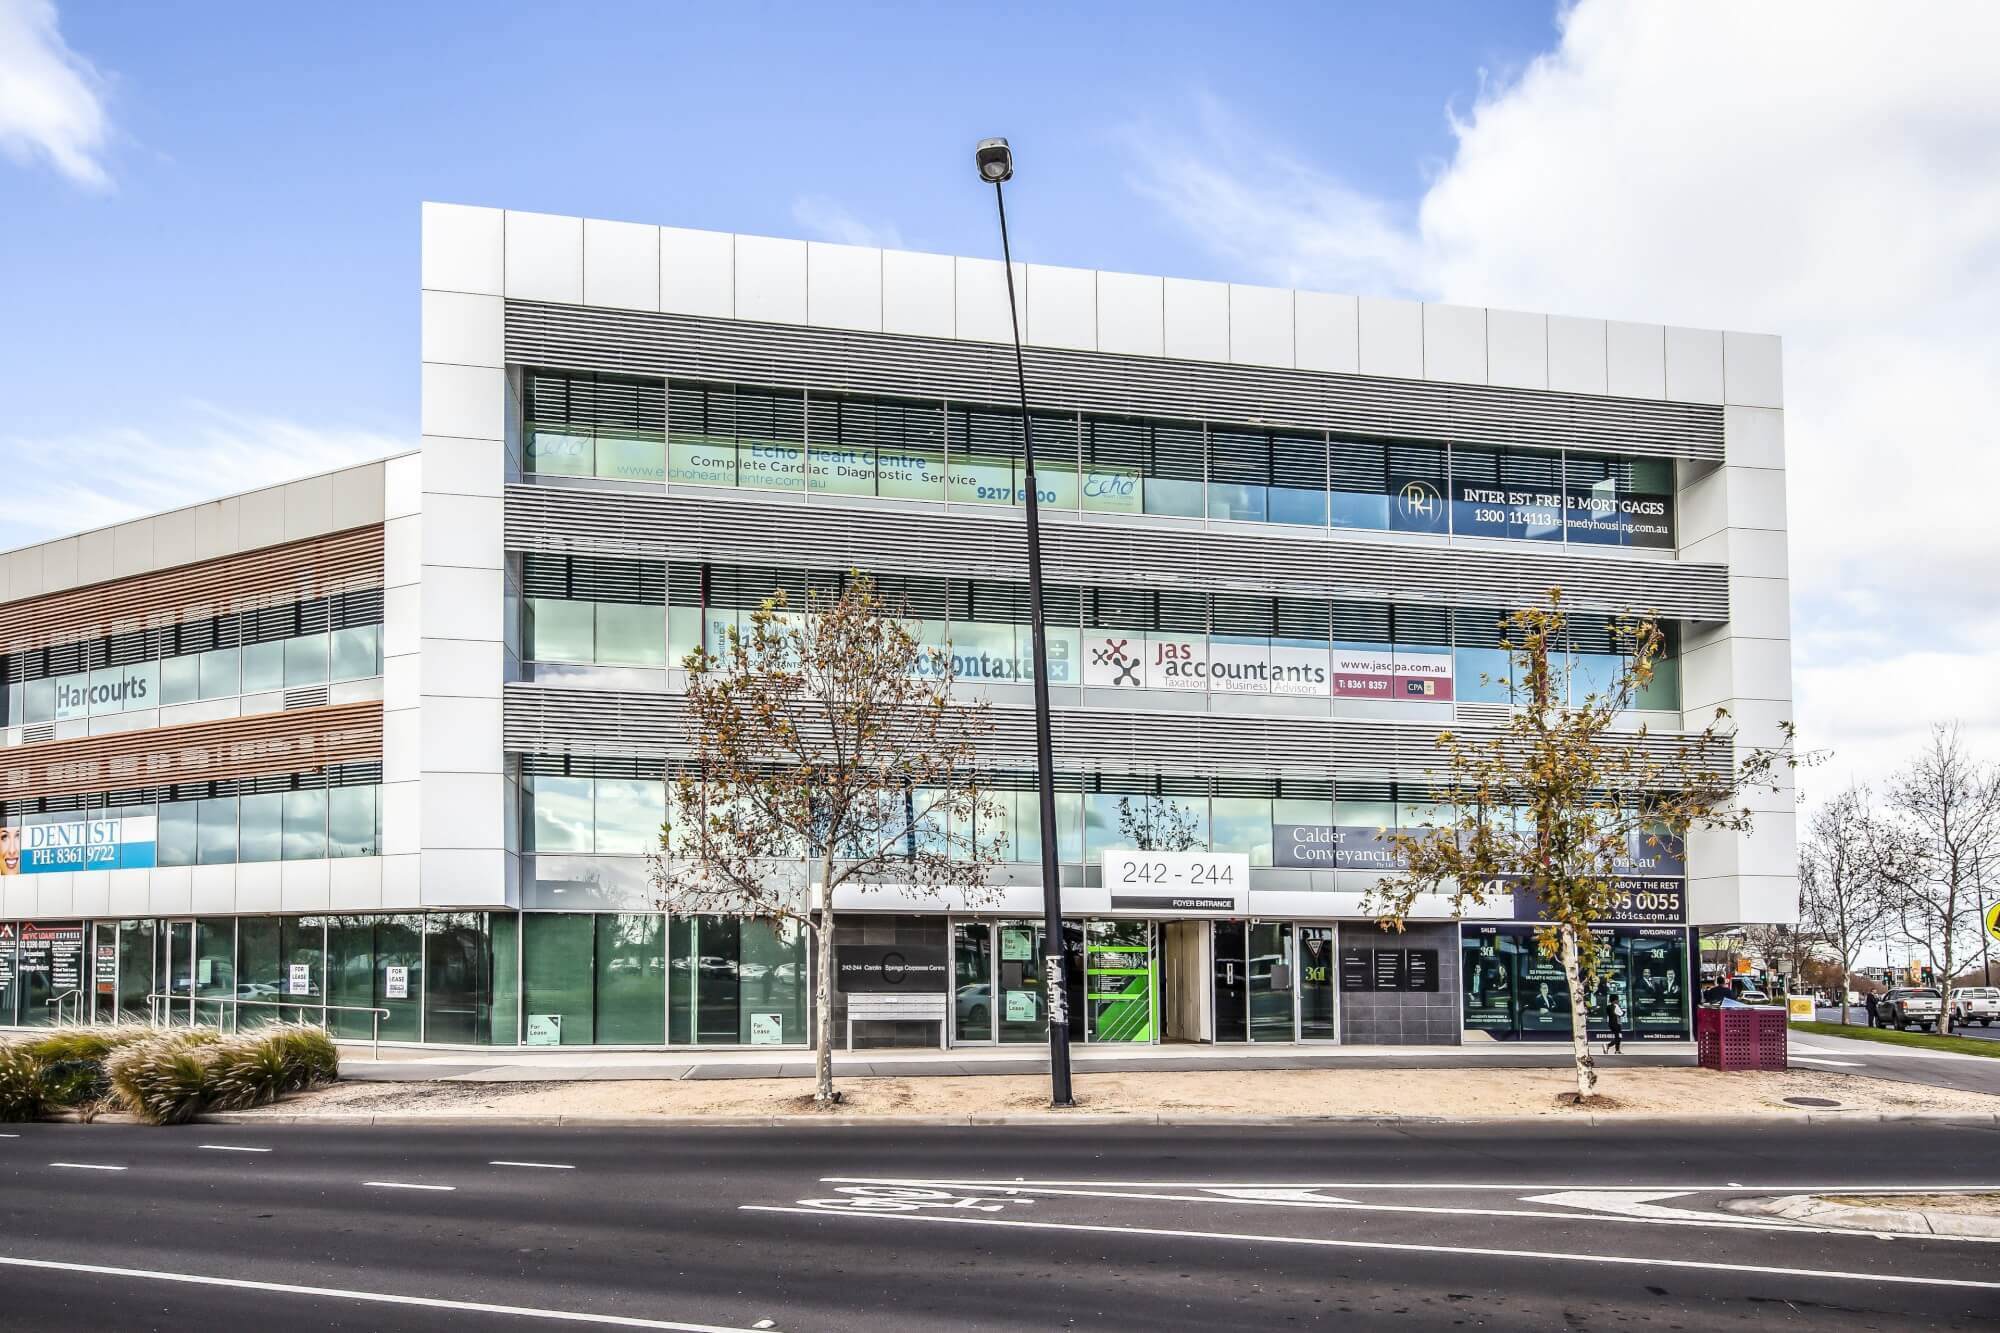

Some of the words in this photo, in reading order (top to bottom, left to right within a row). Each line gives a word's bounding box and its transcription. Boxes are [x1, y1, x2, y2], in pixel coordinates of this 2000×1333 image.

[752, 443, 798, 460] Echo
[807, 446, 857, 464] Heart
[863, 451, 926, 469] Centre
[617, 466, 826, 489] www.echoheartcentre.comau
[690, 455, 767, 471] Complete
[770, 461, 829, 475] Cardiac
[837, 466, 913, 481] Diagnostic
[921, 472, 977, 486] Service
[1084, 470, 1139, 497] Echo
[977, 487, 1011, 500] 9217
[1017, 489, 1056, 503] 600
[1474, 508, 1505, 523] 1300
[1509, 511, 1551, 526] 114113
[1155, 642, 1192, 665] jas
[1165, 660, 1325, 684] accountants
[1340, 660, 1446, 673] www.jascpa.com.au
[57, 676, 147, 708] Harcourts
[1163, 676, 1206, 688] Taxation
[1225, 679, 1268, 691] Business
[1274, 682, 1317, 694] Advisors
[1339, 680, 1346, 688] T:
[1408, 683, 1423, 691] CPA
[30, 821, 119, 848] DENTIST
[1293, 827, 1347, 843] Calder
[32, 849, 54, 865] PH:
[57, 846, 83, 863] 8361
[87, 845, 115, 862] 9722
[1293, 844, 1408, 867] Conveyancing
[1123, 862, 1168, 883] 242
[1191, 863, 1234, 885] 244
[1614, 881, 1641, 889] ABOVE
[1643, 881, 1658, 889] THE
[1659, 882, 1679, 890] REST
[1172, 899, 1195, 907] FOYER
[1195, 899, 1232, 908] ENTRANCE
[1636, 893, 1680, 910] 0055
[1305, 966, 1326, 981] 361
